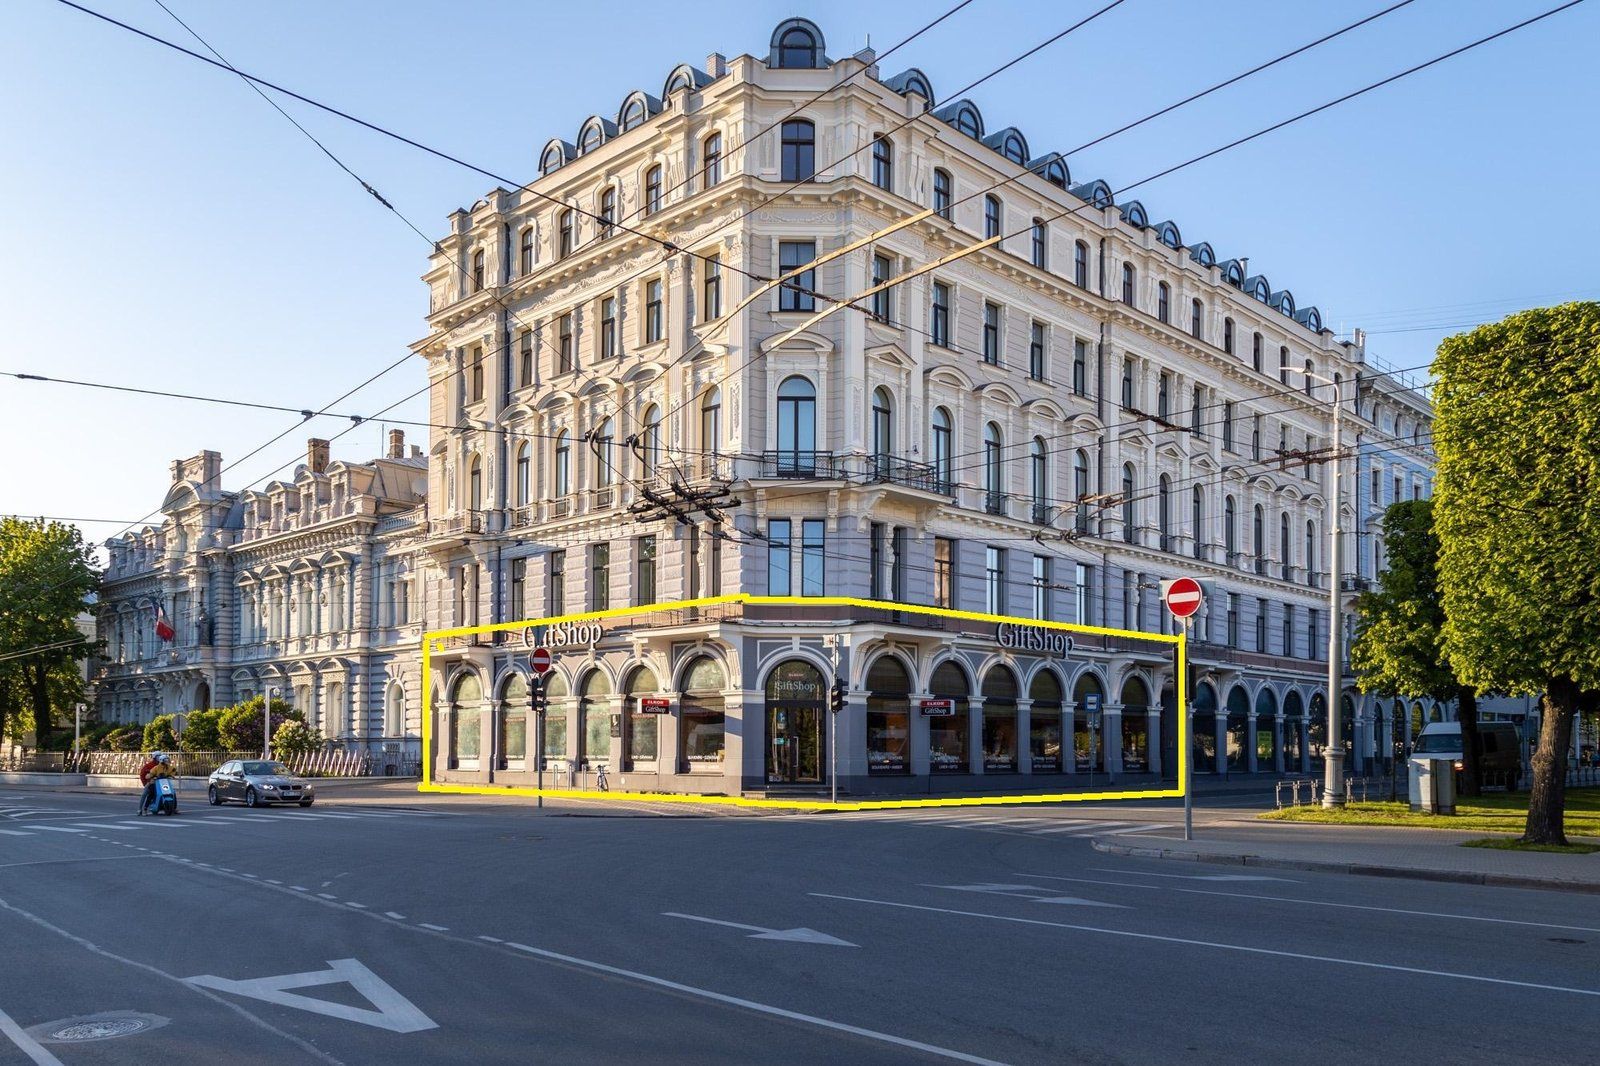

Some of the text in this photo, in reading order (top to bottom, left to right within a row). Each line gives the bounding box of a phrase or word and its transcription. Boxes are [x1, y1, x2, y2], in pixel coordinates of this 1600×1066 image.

[997, 622, 1074, 660] GiftShop
[777, 680, 816, 692] GiftShop
[924, 707, 947, 715] GiftShop
